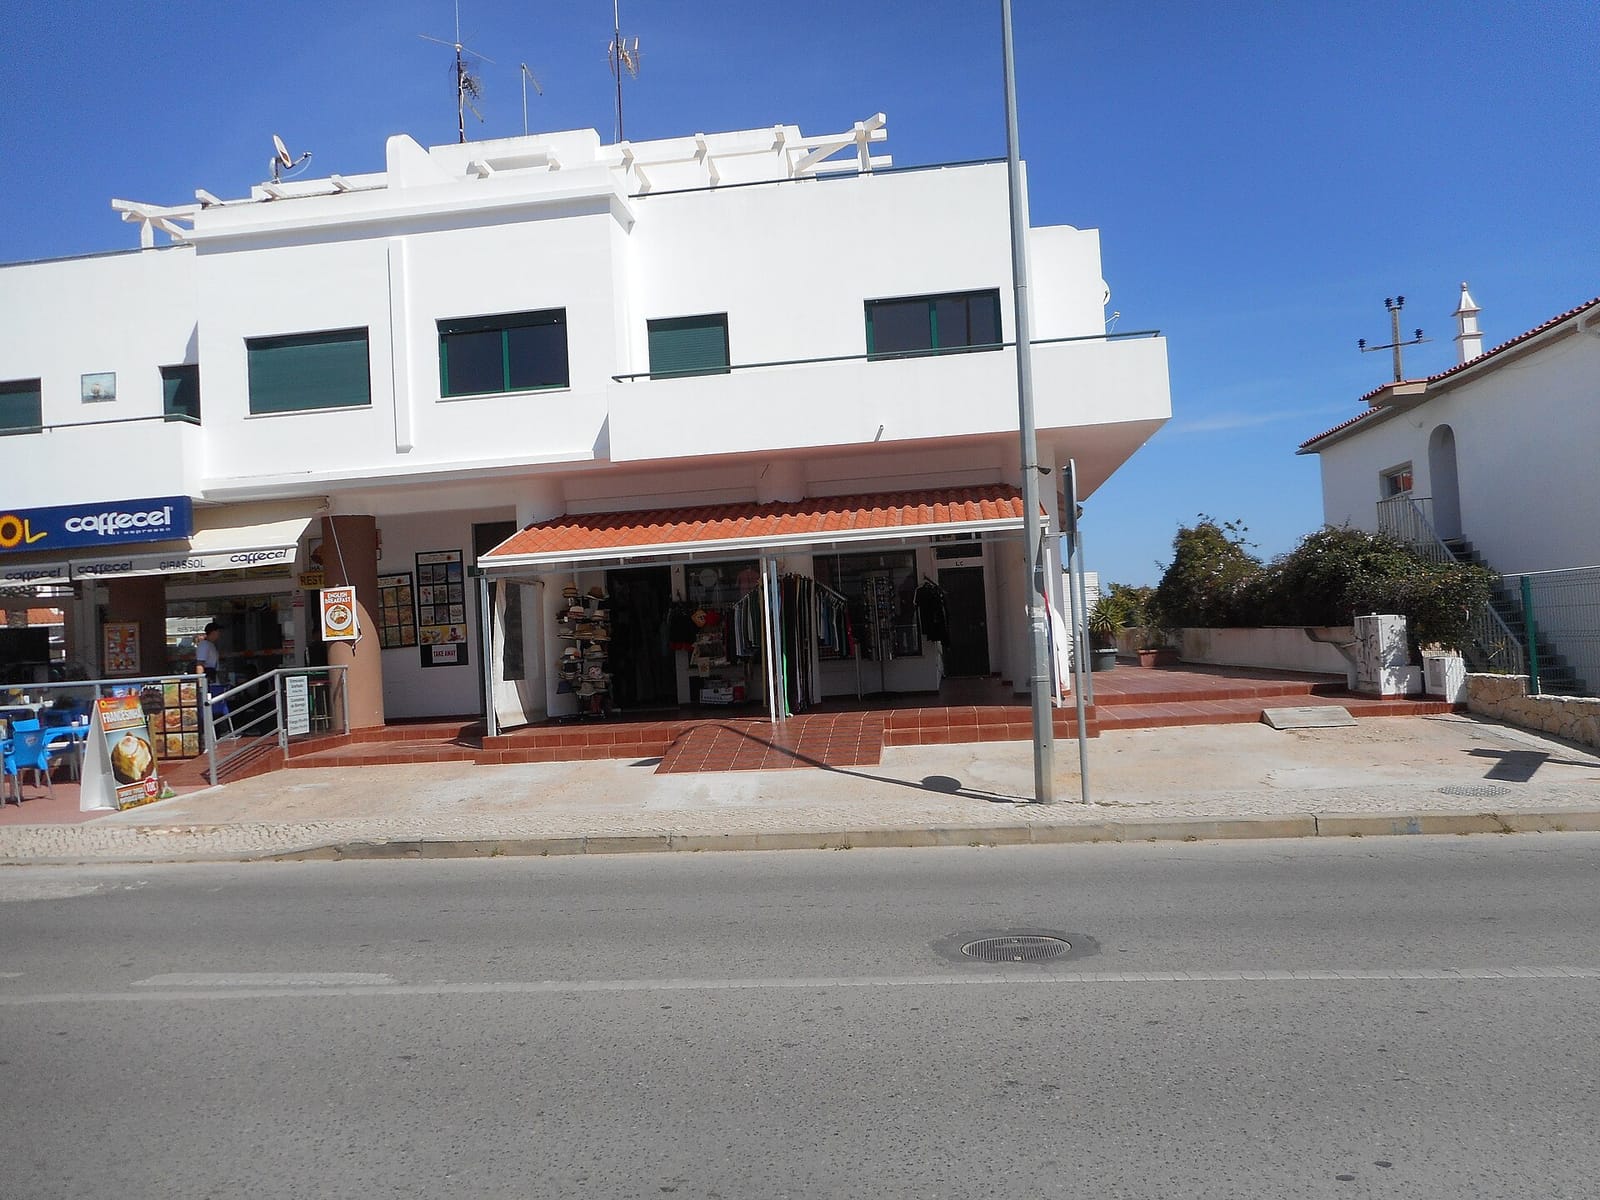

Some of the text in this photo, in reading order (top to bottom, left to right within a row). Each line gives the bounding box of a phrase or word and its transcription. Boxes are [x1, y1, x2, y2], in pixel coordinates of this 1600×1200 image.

[65, 506, 171, 535] caffecel
[77, 549, 287, 575] caffecel GIRASSOL caffecel
[5, 568, 61, 583] caffecel
